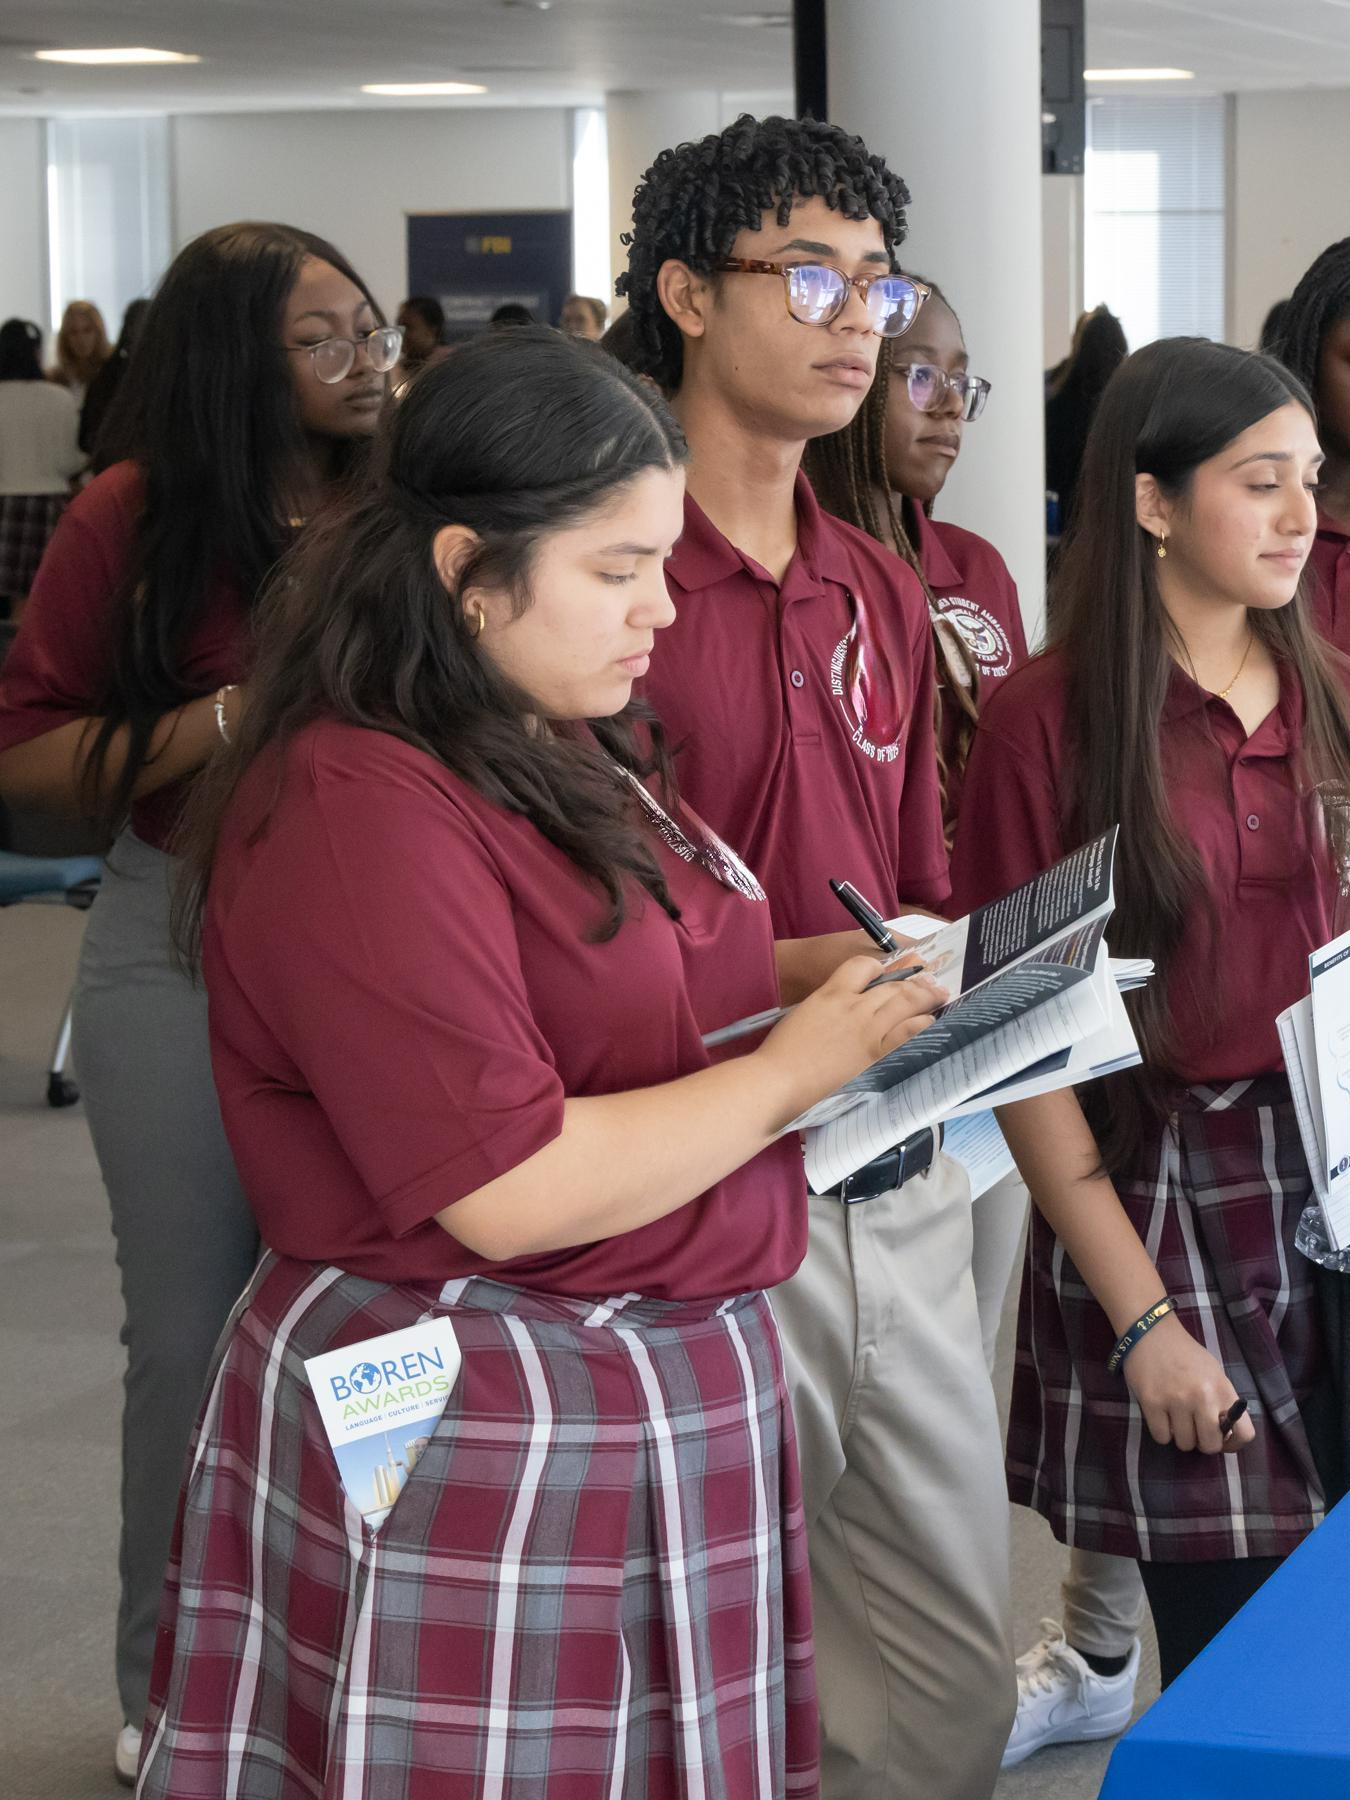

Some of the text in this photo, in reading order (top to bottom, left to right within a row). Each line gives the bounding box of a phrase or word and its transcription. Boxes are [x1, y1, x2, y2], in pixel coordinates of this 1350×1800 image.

[852, 730, 876, 759] CLASS
[876, 748, 886, 763] OF
[1324, 953, 1343, 969] BENEFITS
[343, 1375, 449, 1420] AWARDS
[345, 1415, 383, 1431] LANGUAGE
[388, 1404, 420, 1418] CULTURE
